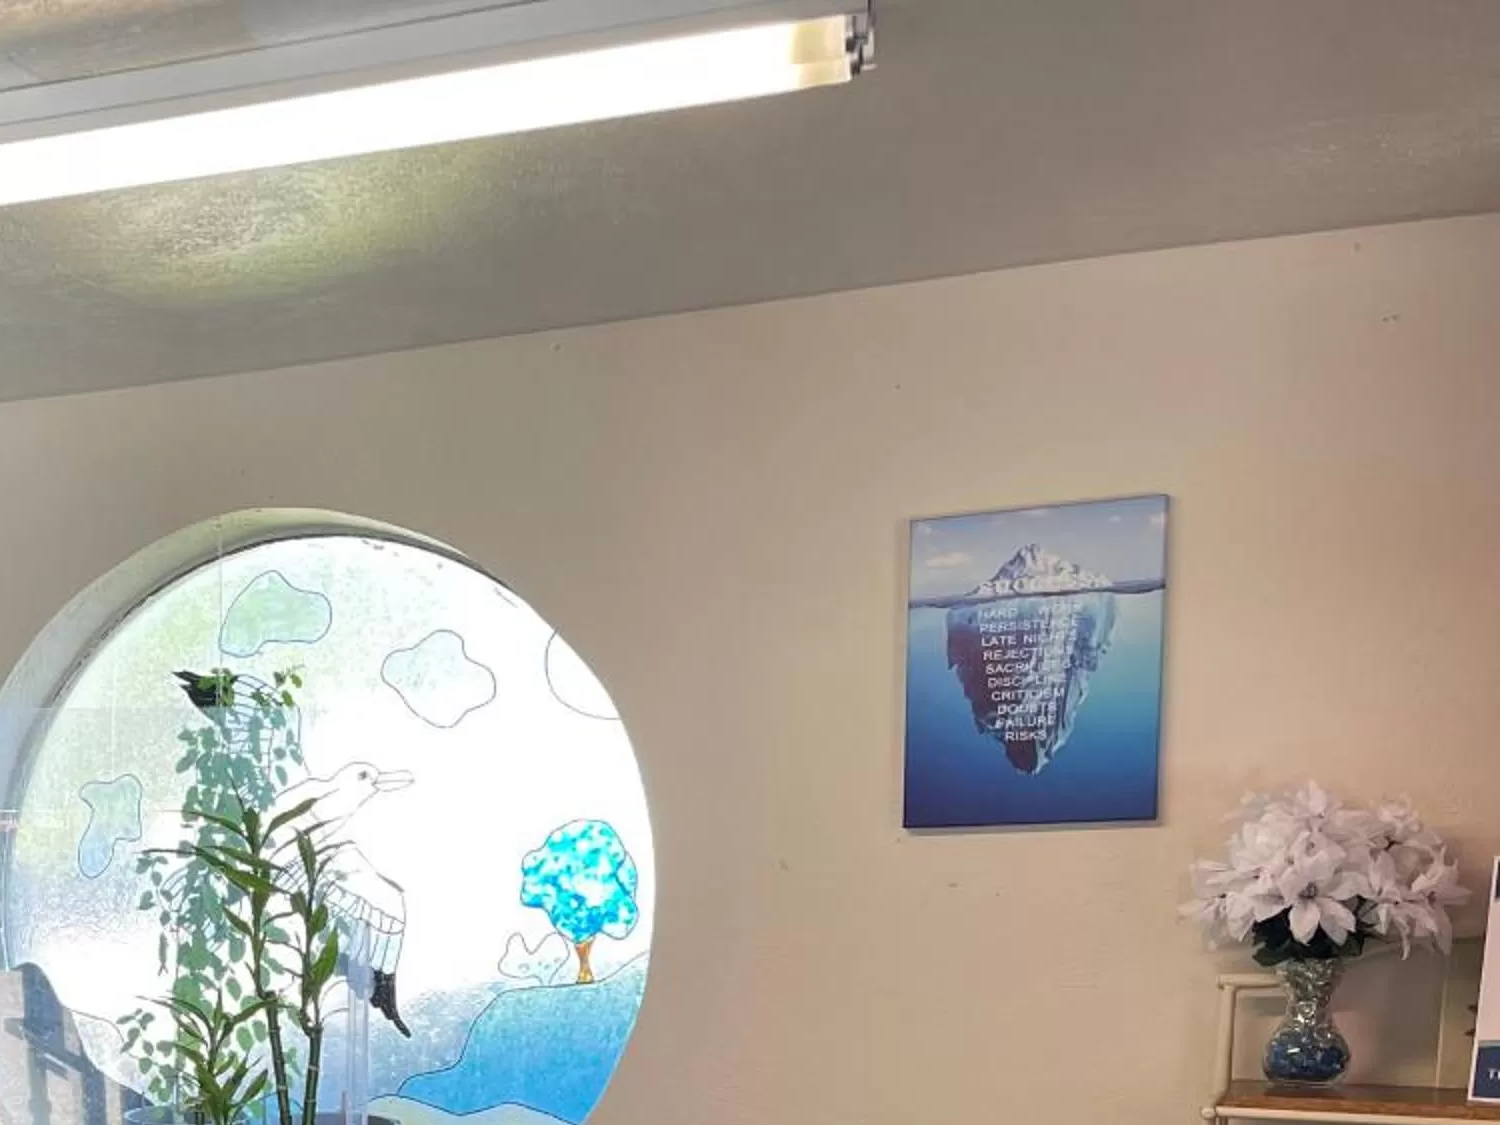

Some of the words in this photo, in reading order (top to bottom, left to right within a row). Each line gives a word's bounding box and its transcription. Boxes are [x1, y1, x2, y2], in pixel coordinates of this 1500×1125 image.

[981, 635, 1017, 647] LATE
[991, 687, 1065, 701] CRITICISM
[997, 702, 1057, 715] DOUBTS
[995, 715, 1057, 730] FAILURE
[1005, 729, 1047, 742] RISKS
